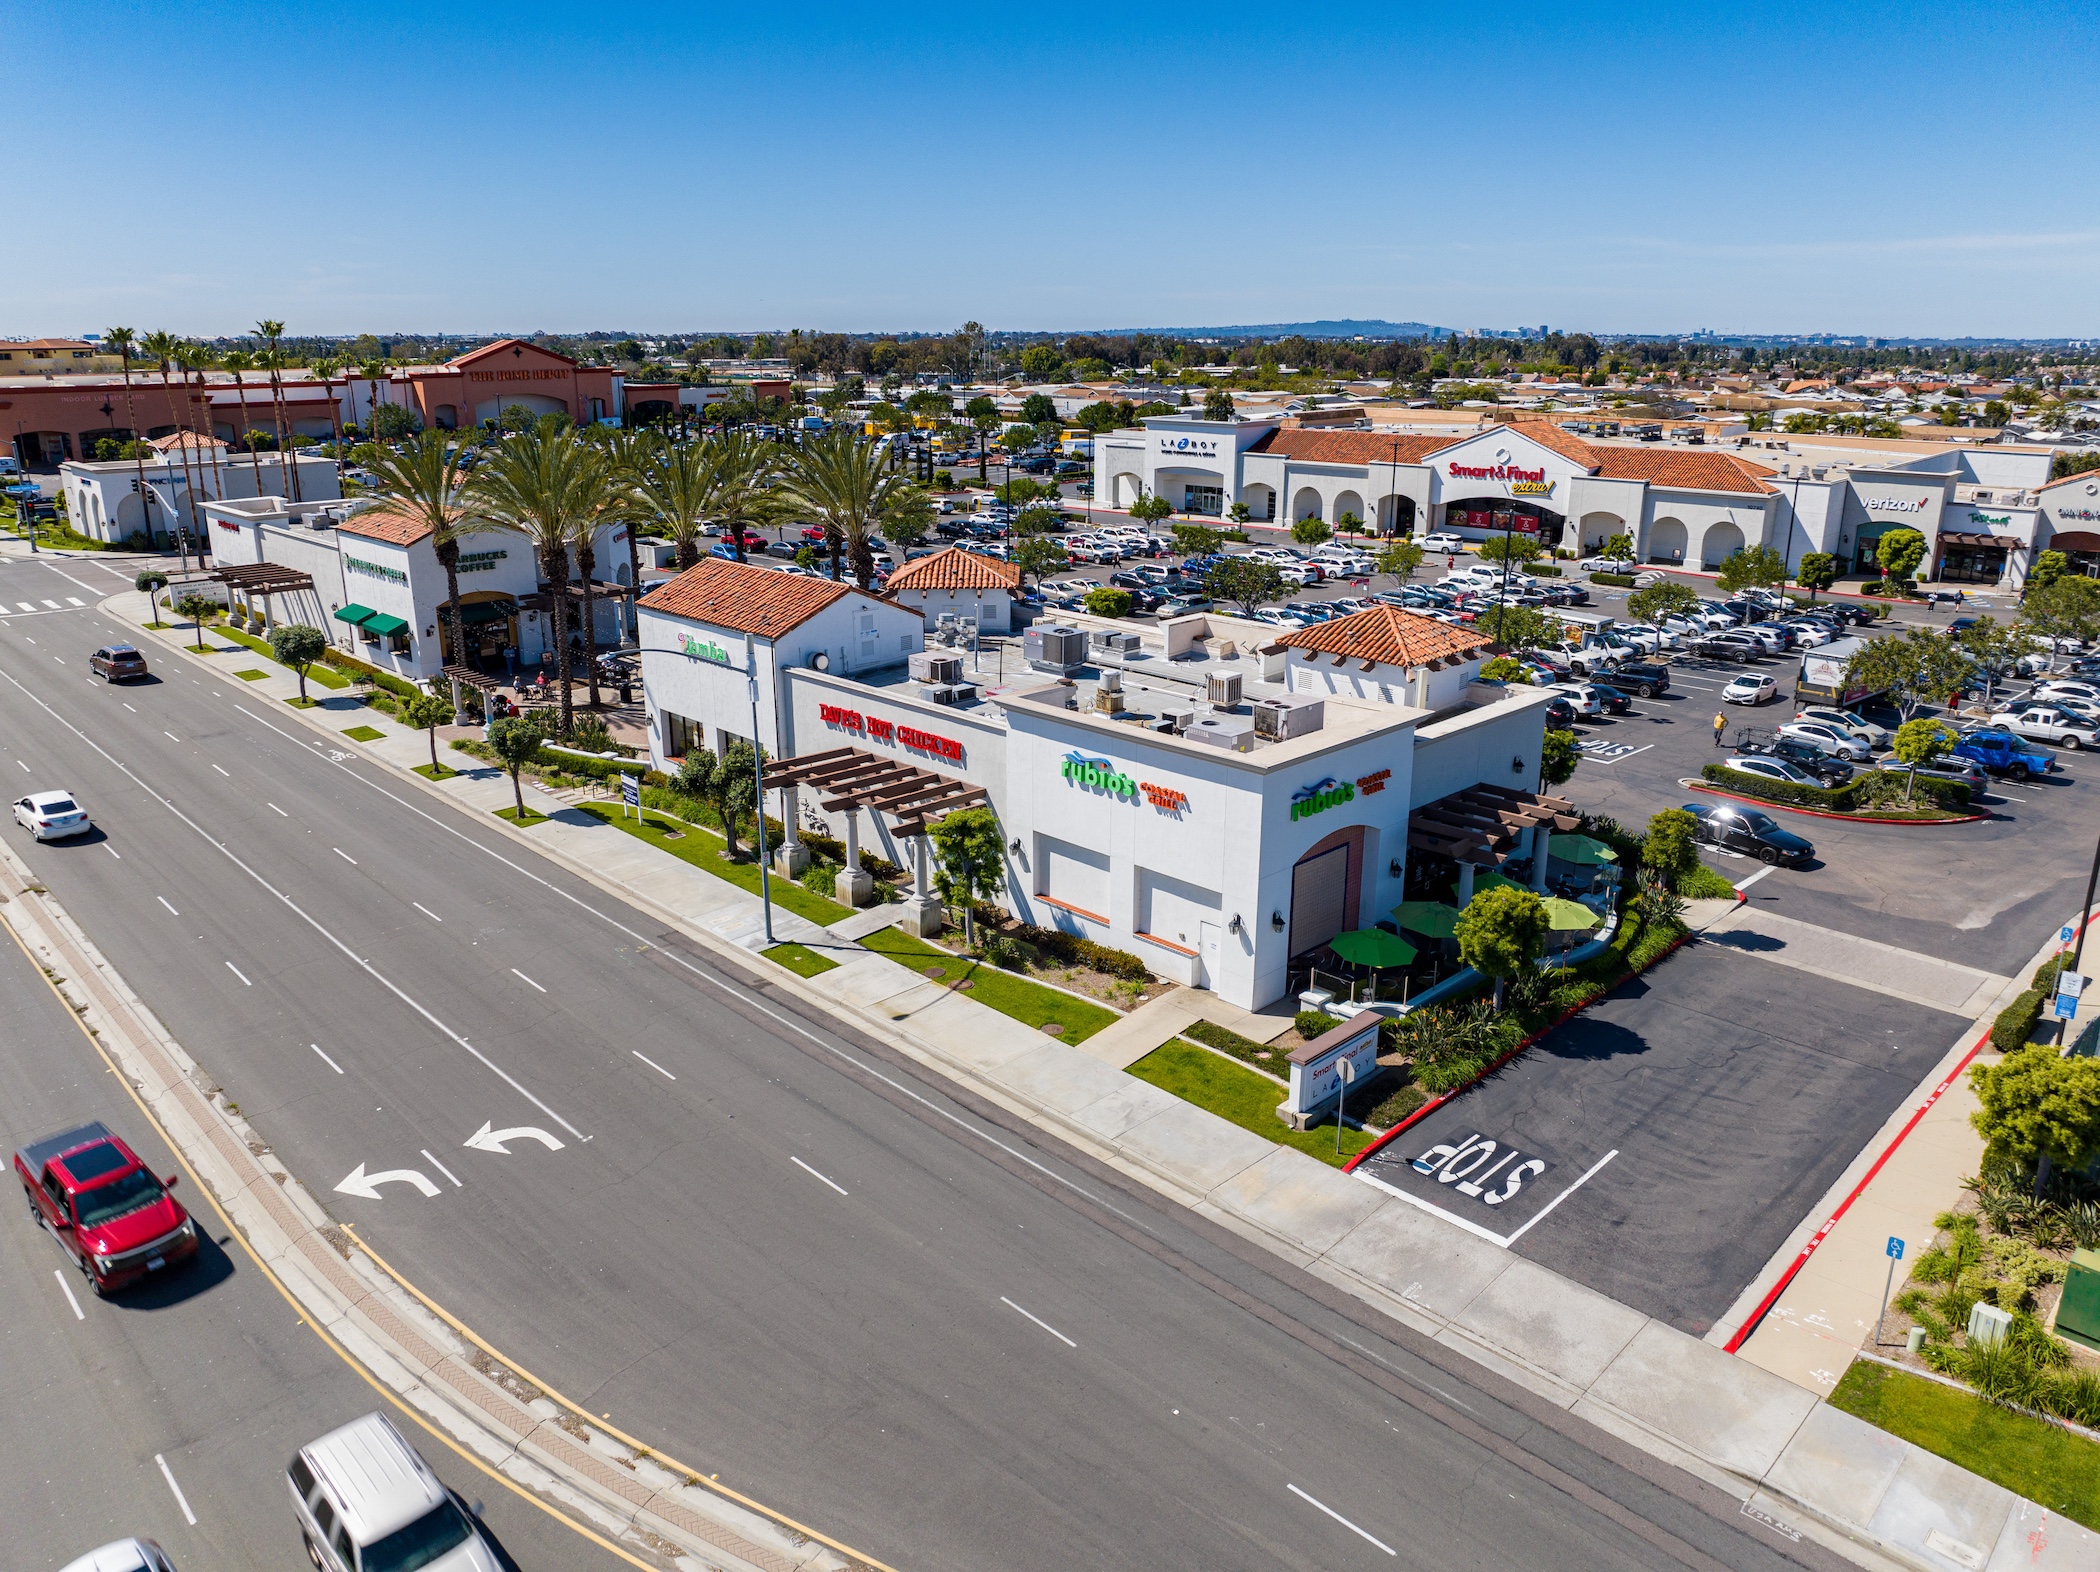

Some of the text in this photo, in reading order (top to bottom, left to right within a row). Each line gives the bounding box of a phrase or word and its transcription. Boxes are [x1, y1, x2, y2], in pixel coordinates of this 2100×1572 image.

[470, 369, 569, 381] THE HOME DEPOT
[1860, 496, 1920, 512] verizon
[456, 550, 508, 563] ARBUCKS
[455, 561, 496, 573] COFFEE
[686, 634, 725, 661] jamba
[819, 703, 962, 760] DAVE'S HOT CHICKEN
[1061, 761, 1135, 797] rubio's
[1140, 782, 1185, 802] COASTAL
[1291, 781, 1355, 822] rubio's
[1148, 795, 1178, 811] GRILL
[1412, 1133, 1546, 1205] STOP
